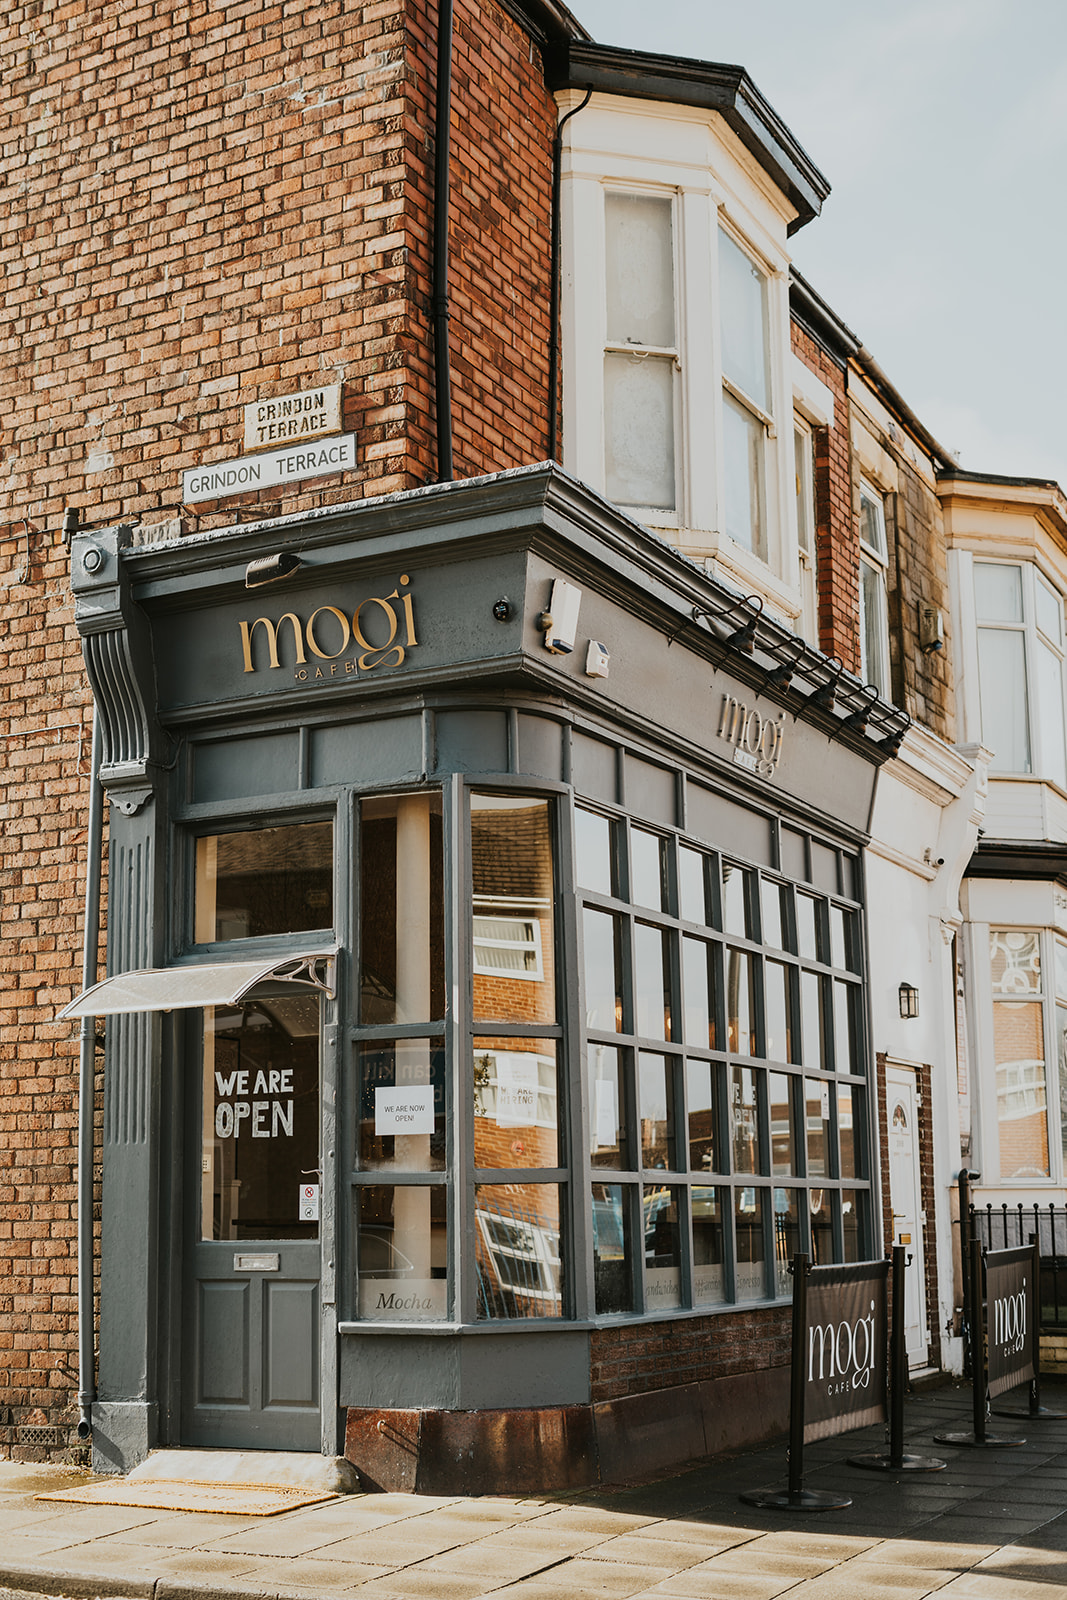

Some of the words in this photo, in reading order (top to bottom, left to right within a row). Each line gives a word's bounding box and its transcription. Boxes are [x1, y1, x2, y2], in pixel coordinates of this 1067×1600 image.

[257, 412, 328, 442] TERRACE
[190, 463, 261, 493] GRINDON
[276, 444, 348, 475] TERRACE
[238, 574, 418, 673] mogi
[298, 661, 352, 680] CAFE
[719, 693, 786, 779] mogi
[214, 1070, 249, 1096] WE
[253, 1069, 294, 1094] ARE
[215, 1100, 294, 1138] OPEN
[384, 1105, 394, 1113] WE
[409, 1104, 425, 1112] NOW
[375, 1292, 432, 1310] Mocha
[995, 1277, 1026, 1352] mogi
[808, 1300, 875, 1389] mogi
[1004, 1344, 1016, 1358] CAE
[827, 1380, 850, 1396] CAFE
